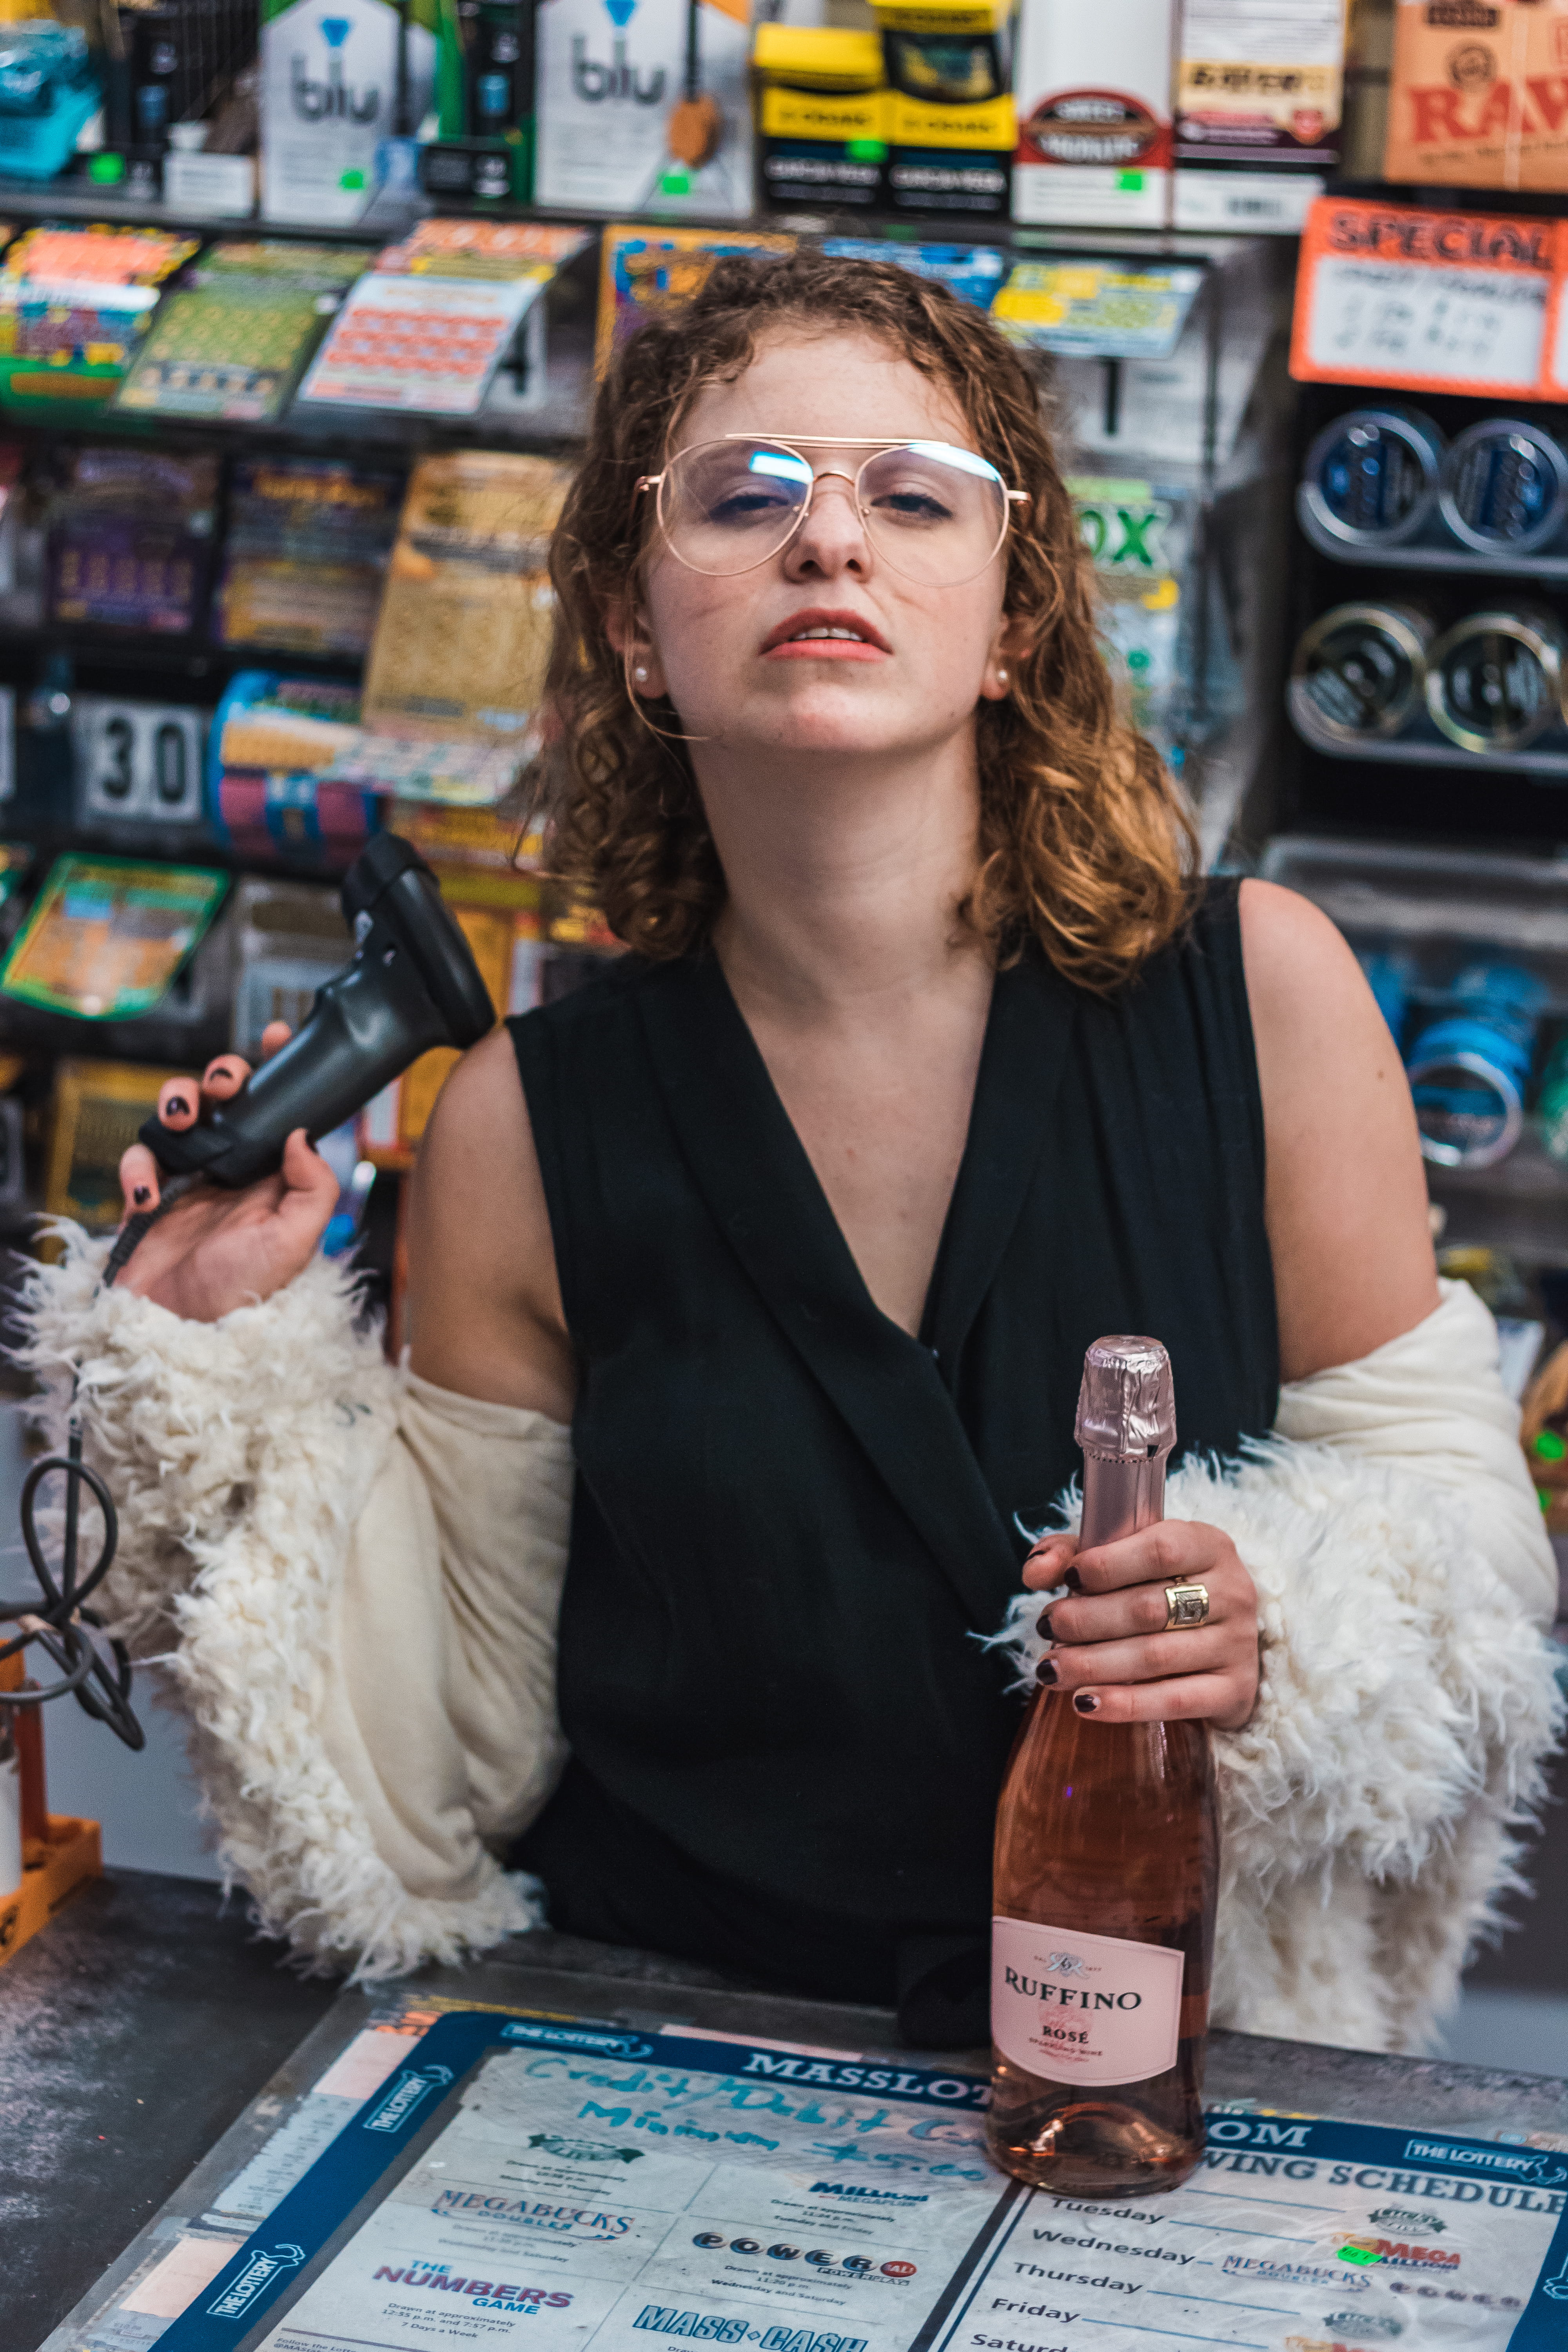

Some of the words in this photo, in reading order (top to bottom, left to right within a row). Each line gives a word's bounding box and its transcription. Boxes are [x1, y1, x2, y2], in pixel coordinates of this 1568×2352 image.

[571, 32, 668, 105] blu
[289, 51, 380, 125] blu
[1332, 211, 1554, 271] SPECIAL
[103, 717, 187, 804] 30
[1005, 1965, 1142, 2010] RUFFINO
[1042, 2025, 1089, 2044] ROSÉ
[1413, 2143, 1449, 2160] THE
[1450, 2149, 1534, 2172] LOTTERY
[1328, 2165, 1566, 2216] SCHEDULE
[432, 2189, 635, 2234] MEGABUCKS
[1051, 2197, 1165, 2225] Tuesday
[1033, 2228, 1196, 2265] Wednesday
[1373, 2239, 1461, 2265] MEGA
[230, 2257, 279, 2298] LOTTERY
[411, 2260, 454, 2274] THE
[1014, 2261, 1143, 2294] Thursday
[1221, 2255, 1372, 2288] MEGABUCKS
[372, 2265, 575, 2308] NUMBERS
[711, 2279, 772, 2294] Wednesday
[798, 2292, 846, 2305] Saturday
[214, 2295, 247, 2314] THE
[388, 2303, 423, 2313] Drawn
[438, 2310, 516, 2328] approximately
[472, 2298, 541, 2315] GAME
[991, 2298, 1082, 2323] Friday
[410, 2323, 436, 2332] Days
[449, 2329, 478, 2338] Week
[632, 2305, 750, 2343] MASS
